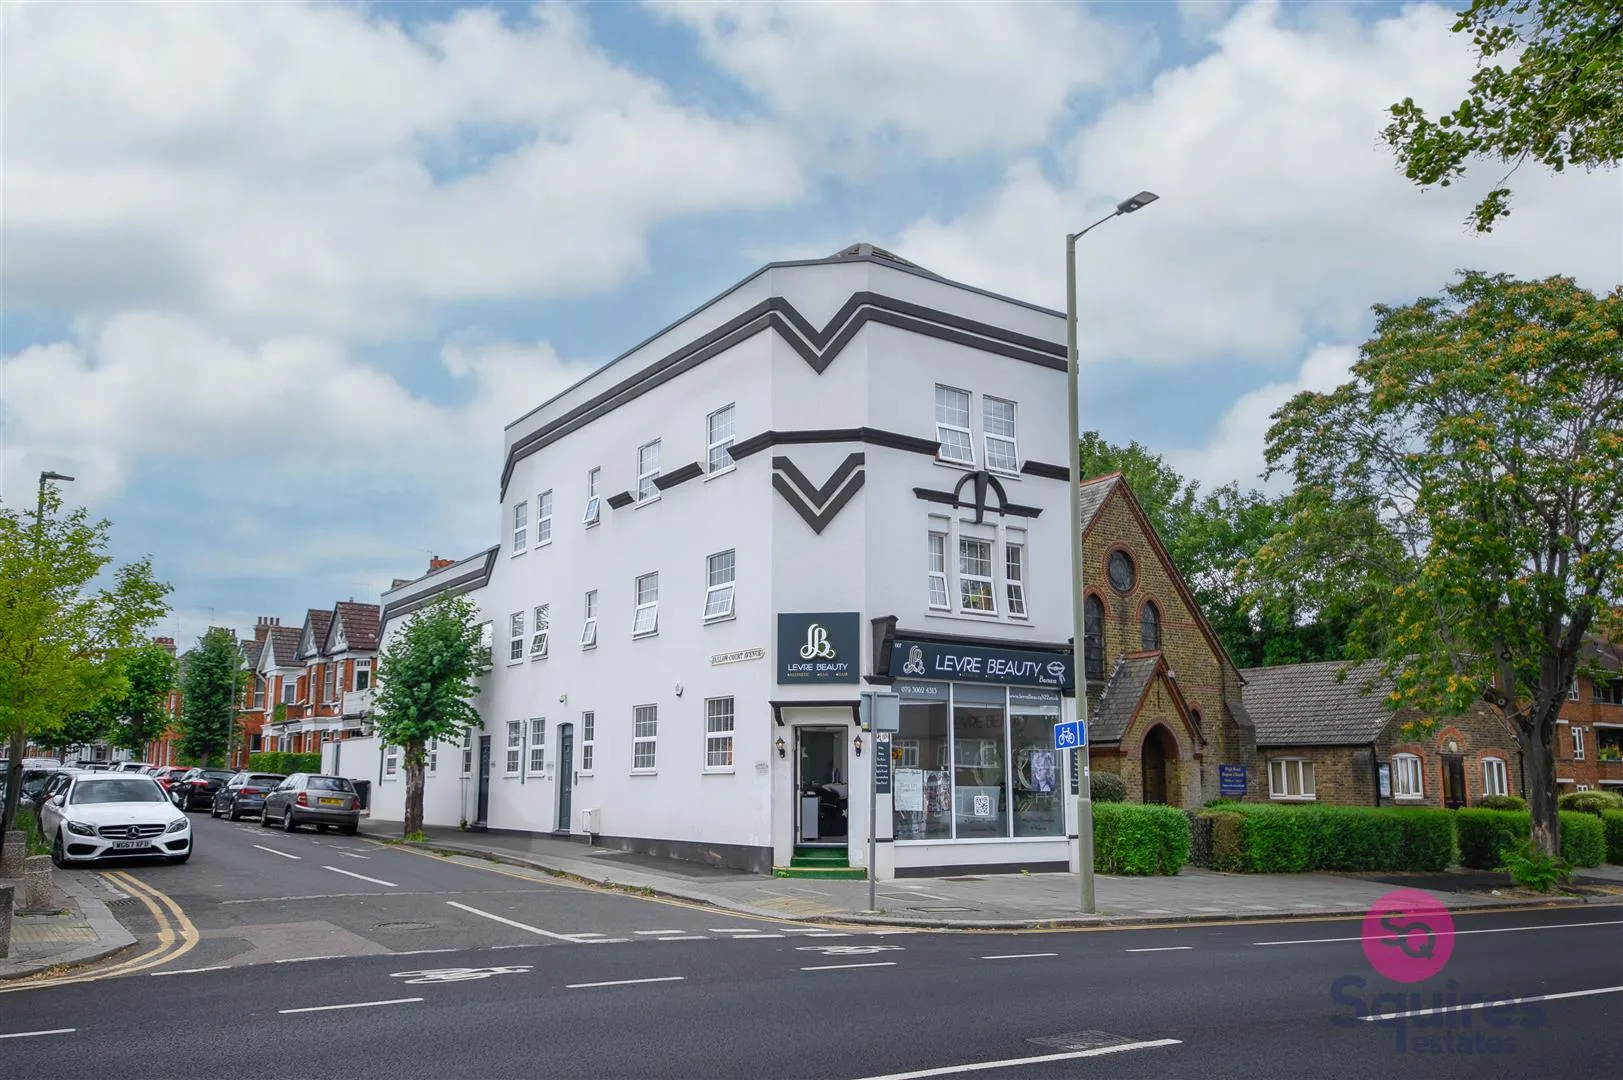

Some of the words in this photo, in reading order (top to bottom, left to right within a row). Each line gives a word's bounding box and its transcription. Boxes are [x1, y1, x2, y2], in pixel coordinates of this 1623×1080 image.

[787, 663, 813, 671] LEVRE
[816, 663, 848, 671] BEAUTY
[935, 654, 982, 673] LEVRE
[987, 659, 1042, 677] BEAUTY
